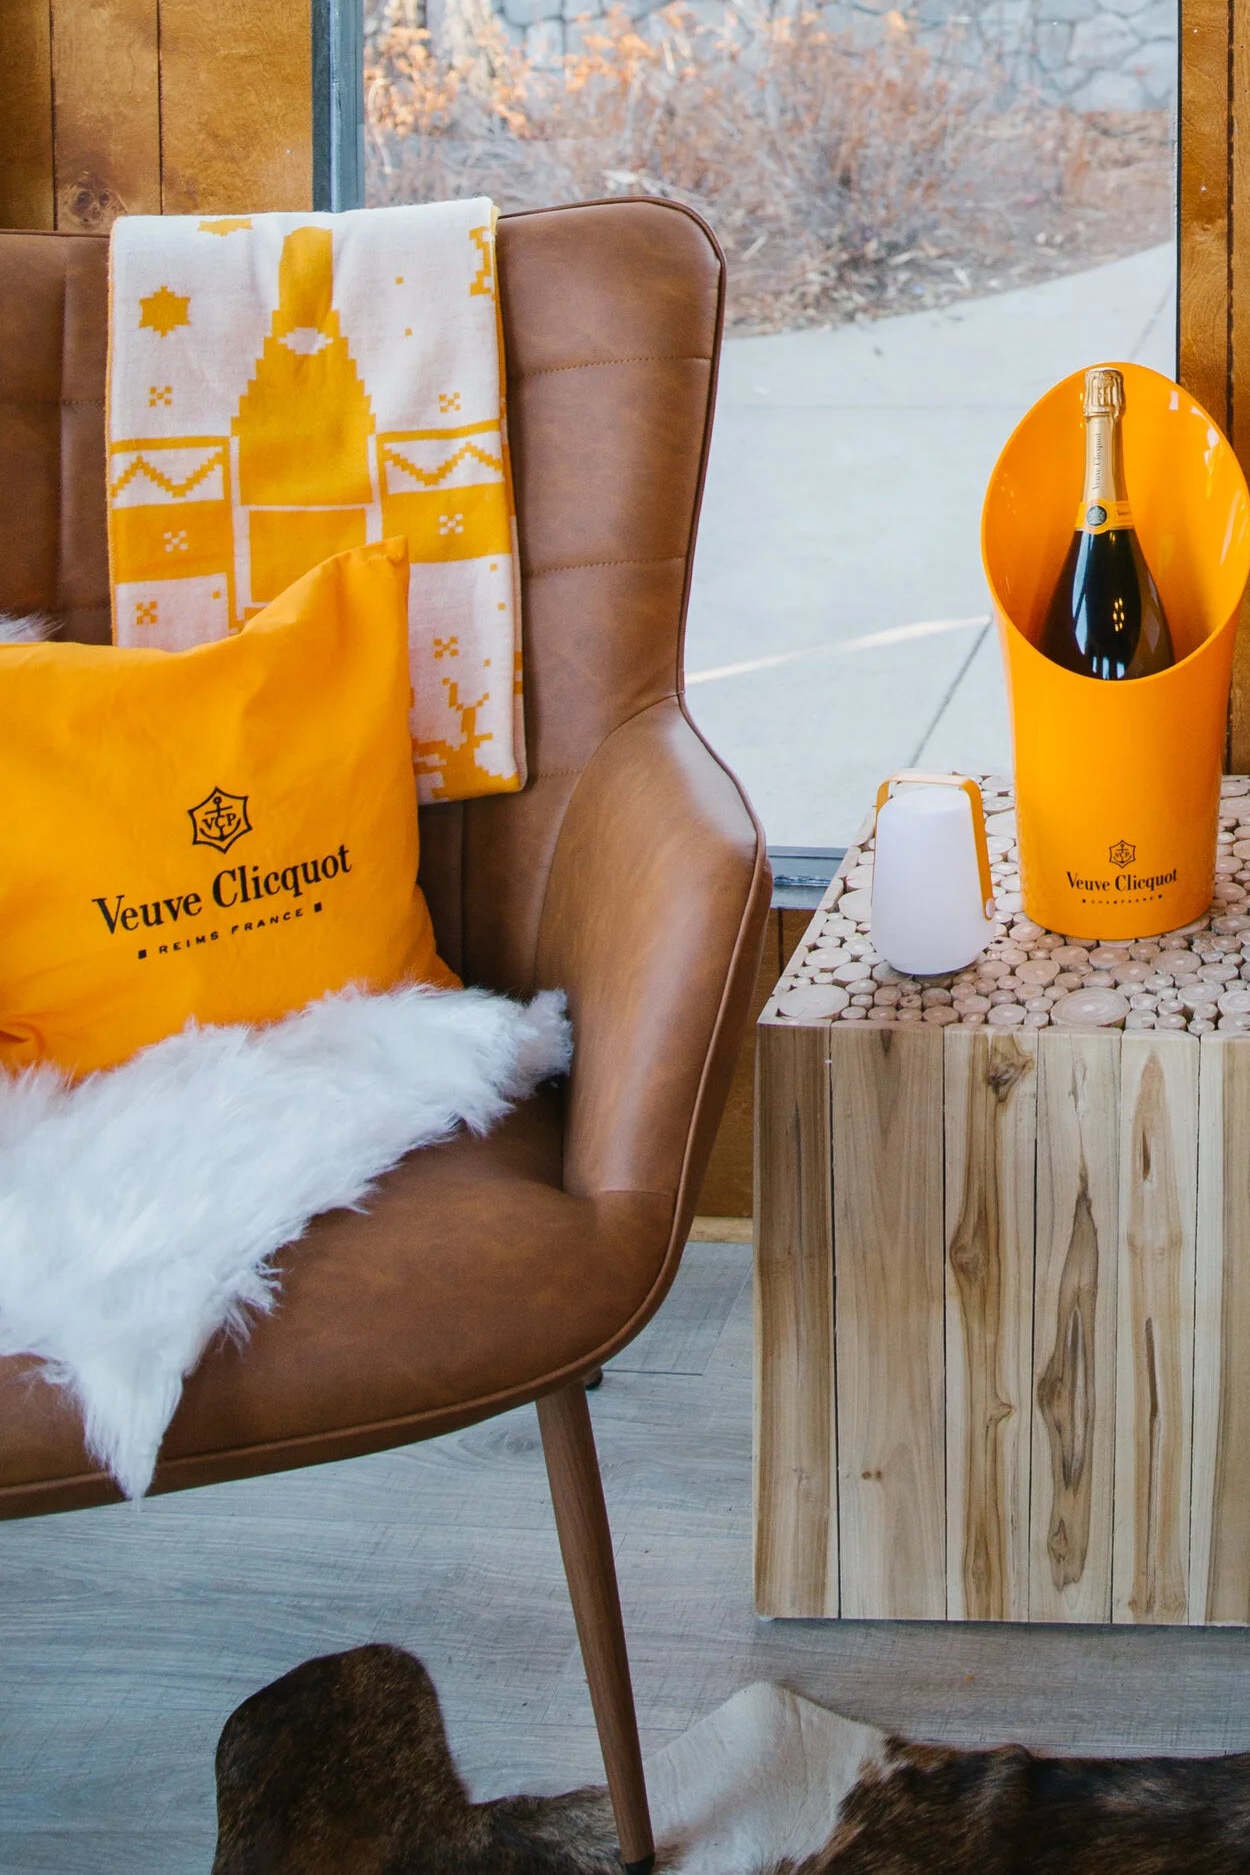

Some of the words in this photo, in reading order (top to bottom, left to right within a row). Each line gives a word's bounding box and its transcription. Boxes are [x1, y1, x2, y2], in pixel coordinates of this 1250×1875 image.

[92, 892, 202, 935] Veuve
[212, 844, 352, 908] Clicquot
[1066, 871, 1110, 891] Veuve
[1114, 868, 1177, 891] Clicquot
[158, 930, 219, 954] REIMS
[231, 907, 304, 935] FRANCE
